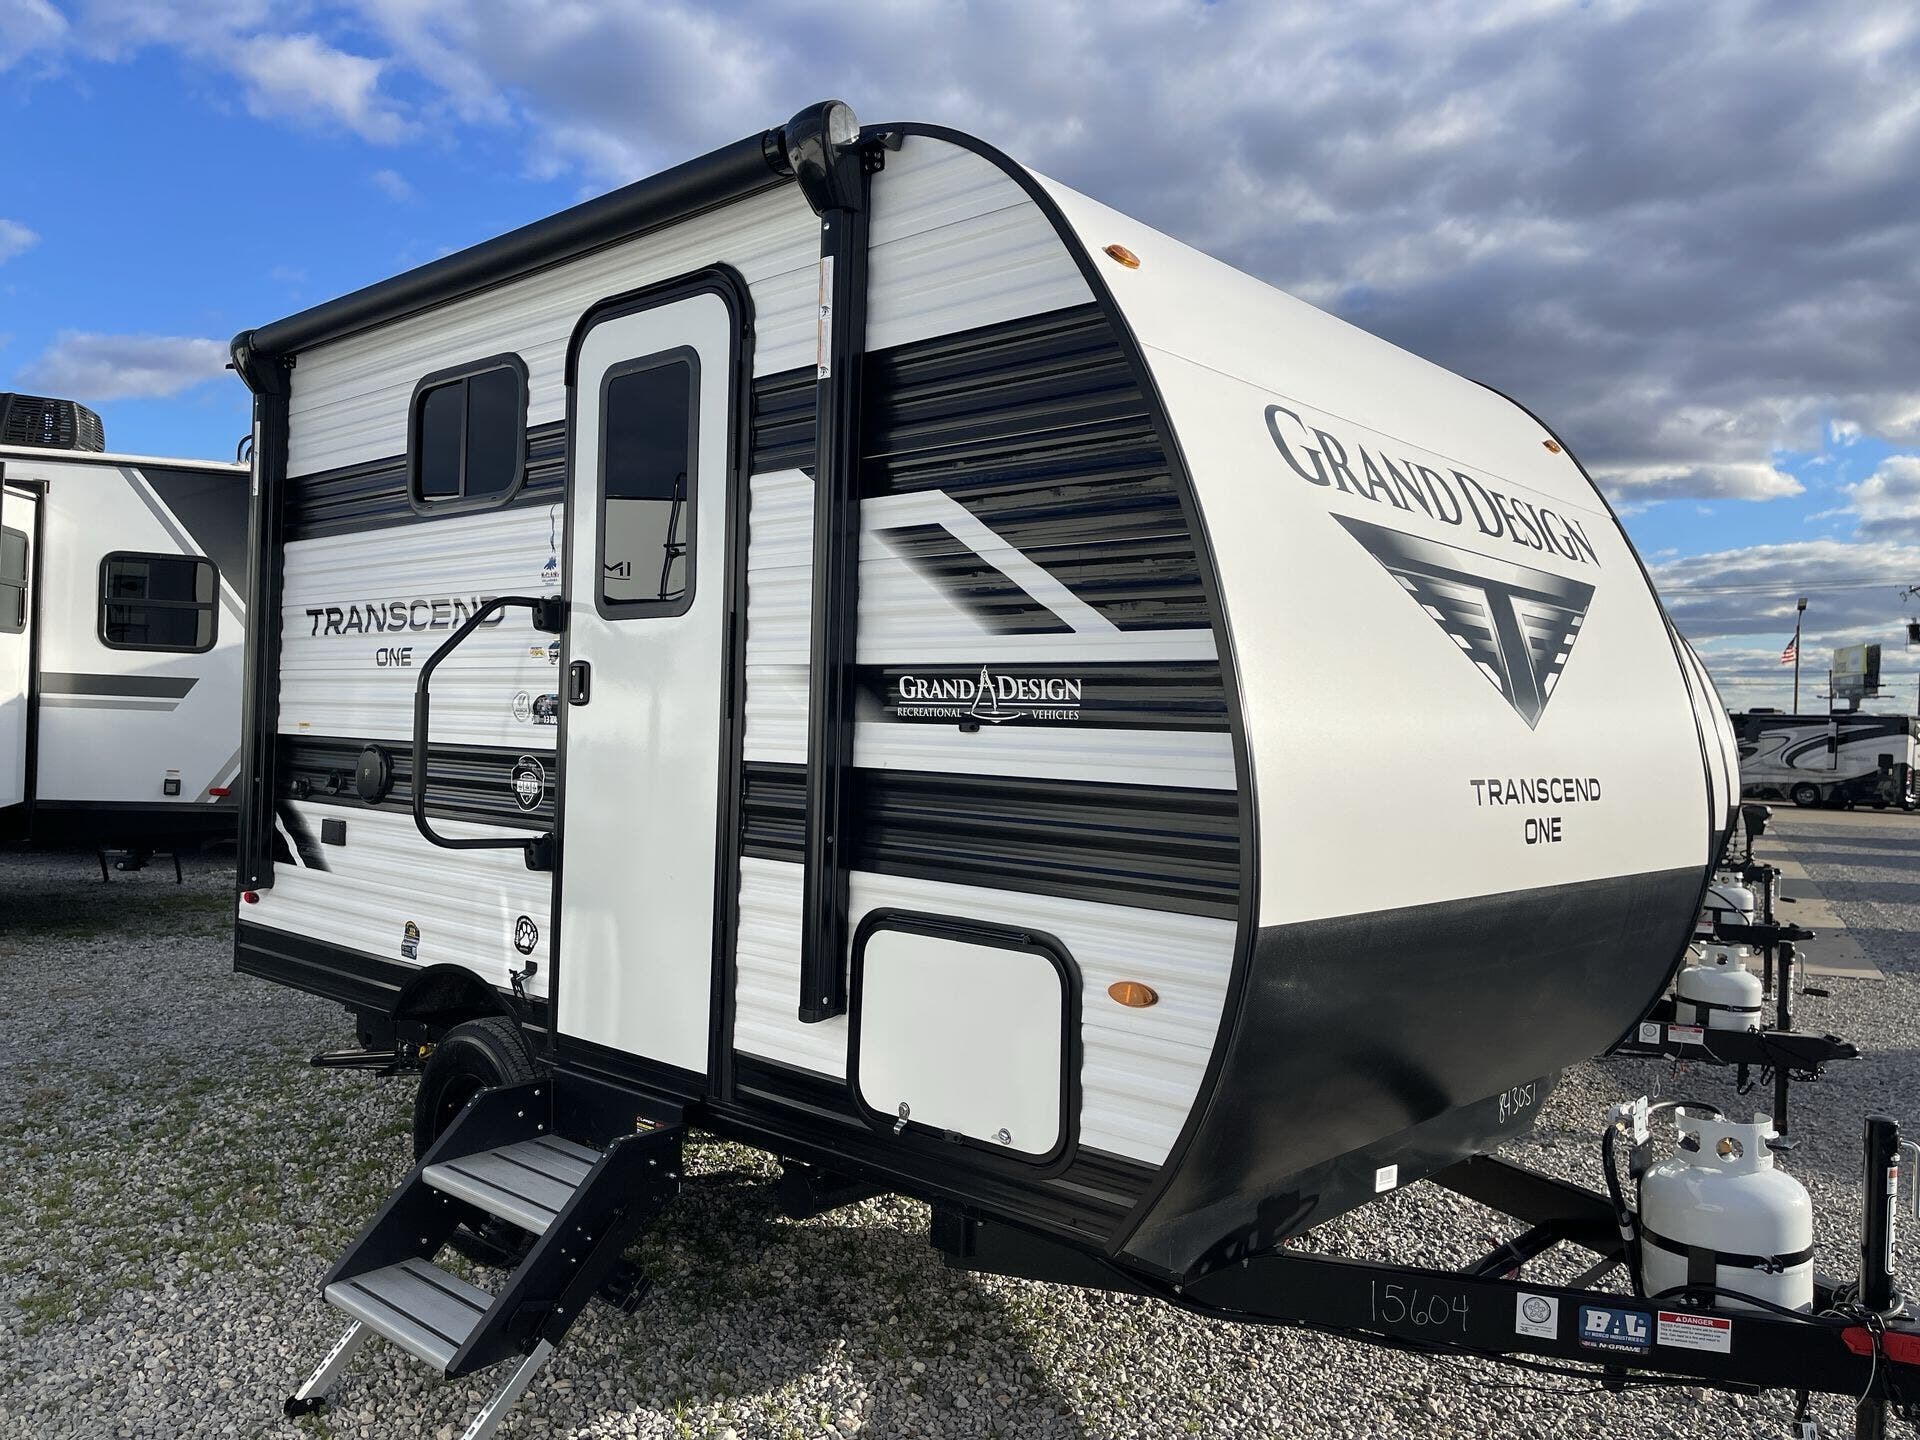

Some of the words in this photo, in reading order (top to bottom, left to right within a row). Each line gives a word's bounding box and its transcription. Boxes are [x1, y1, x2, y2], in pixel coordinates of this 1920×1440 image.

[305, 594, 506, 636] TRANSCEND
[375, 647, 414, 667] ONE
[898, 675, 976, 700] GRAND
[995, 675, 1082, 701] DESIGN
[897, 706, 962, 718] RECREATIONAL
[1032, 709, 1079, 721] VEHICLES
[1469, 777, 1601, 806] TRANSCEND
[1524, 816, 1562, 844] ONE
[1498, 1082, 1537, 1124] 843051
[1371, 1279, 1470, 1332] 15604
[1681, 1316, 1714, 1326] DANGER
